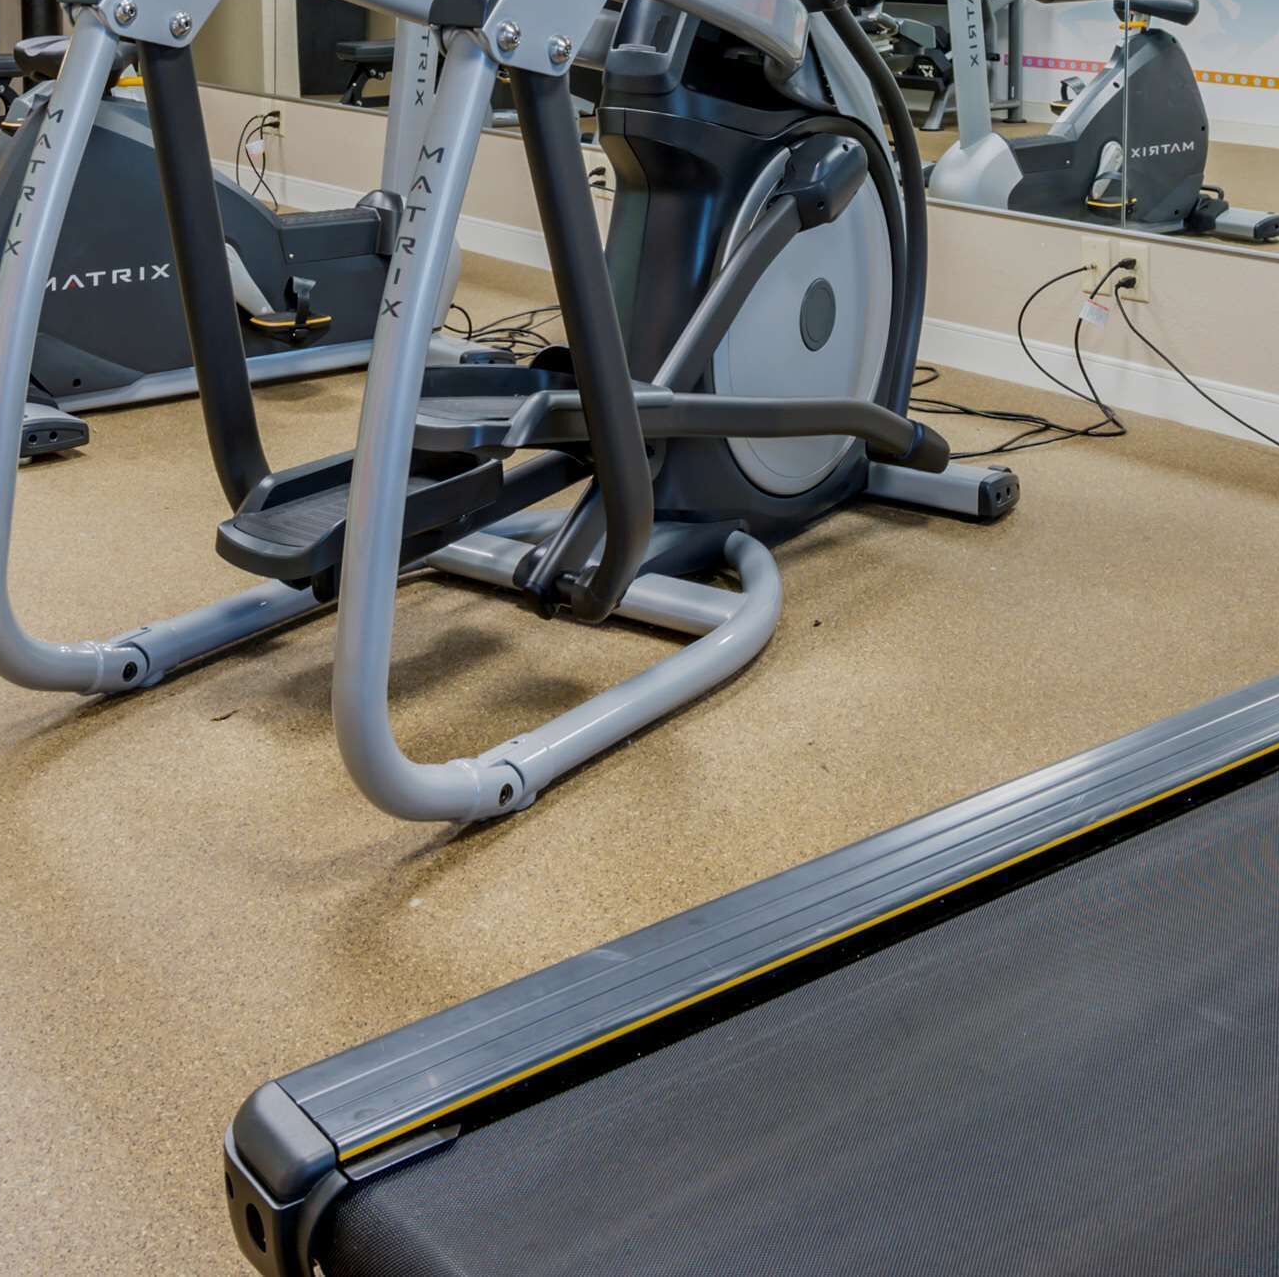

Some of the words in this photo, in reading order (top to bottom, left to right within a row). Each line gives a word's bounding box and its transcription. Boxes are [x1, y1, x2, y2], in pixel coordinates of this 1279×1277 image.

[414, 31, 430, 106] TRIX
[5, 109, 64, 256] MATRIX
[381, 145, 445, 319] MATRIX
[45, 263, 170, 292] MATRIX
